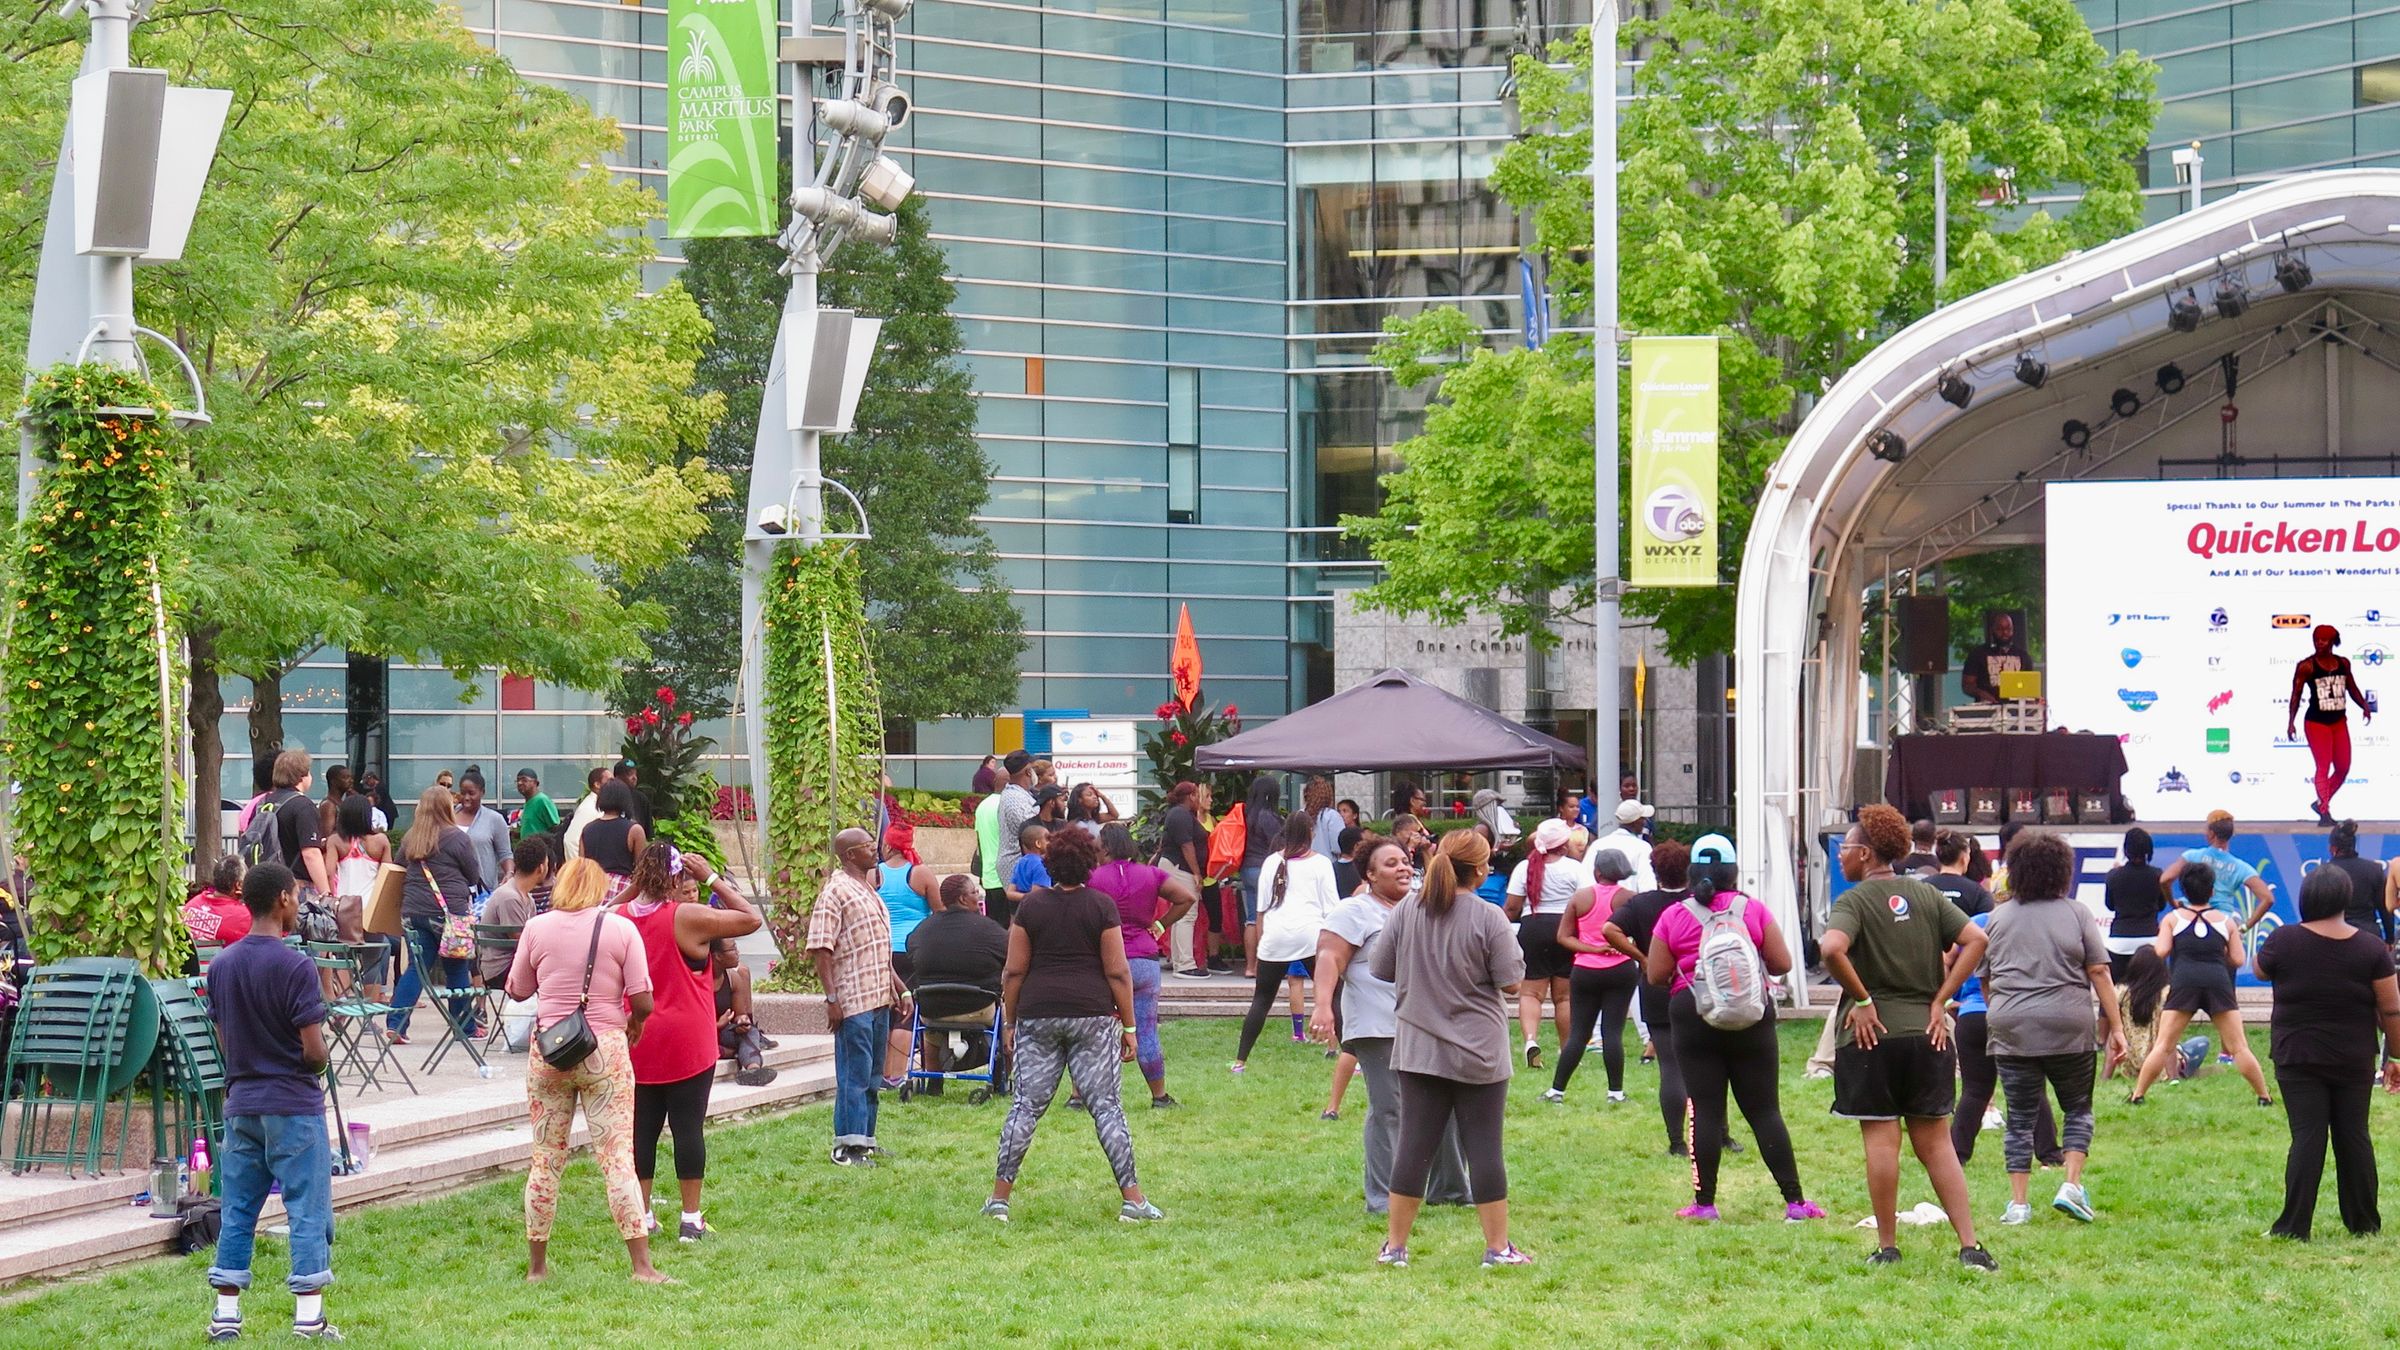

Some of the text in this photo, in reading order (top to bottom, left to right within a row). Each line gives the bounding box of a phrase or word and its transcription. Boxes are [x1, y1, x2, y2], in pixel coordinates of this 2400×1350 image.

[678, 85, 743, 99] CAMPUS
[679, 99, 772, 118] MARTIUS
[679, 119, 718, 133] PARK
[678, 133, 719, 142] DETROIT
[1652, 428, 1717, 443] Summer
[2166, 499, 2395, 511] Special Thanks to Our Summer In The Parks
[1680, 517, 1705, 531] abc
[2187, 521, 2348, 559] Quicken
[1644, 546, 1702, 556] WXYZ
[2209, 569, 2231, 577] And
[2288, 568, 2331, 576] Season's
[2335, 568, 2391, 576] Wonderful
[1417, 639, 1446, 653] One
[1470, 639, 1523, 655] Campu
[1055, 760, 1128, 770] Quicken Loans
